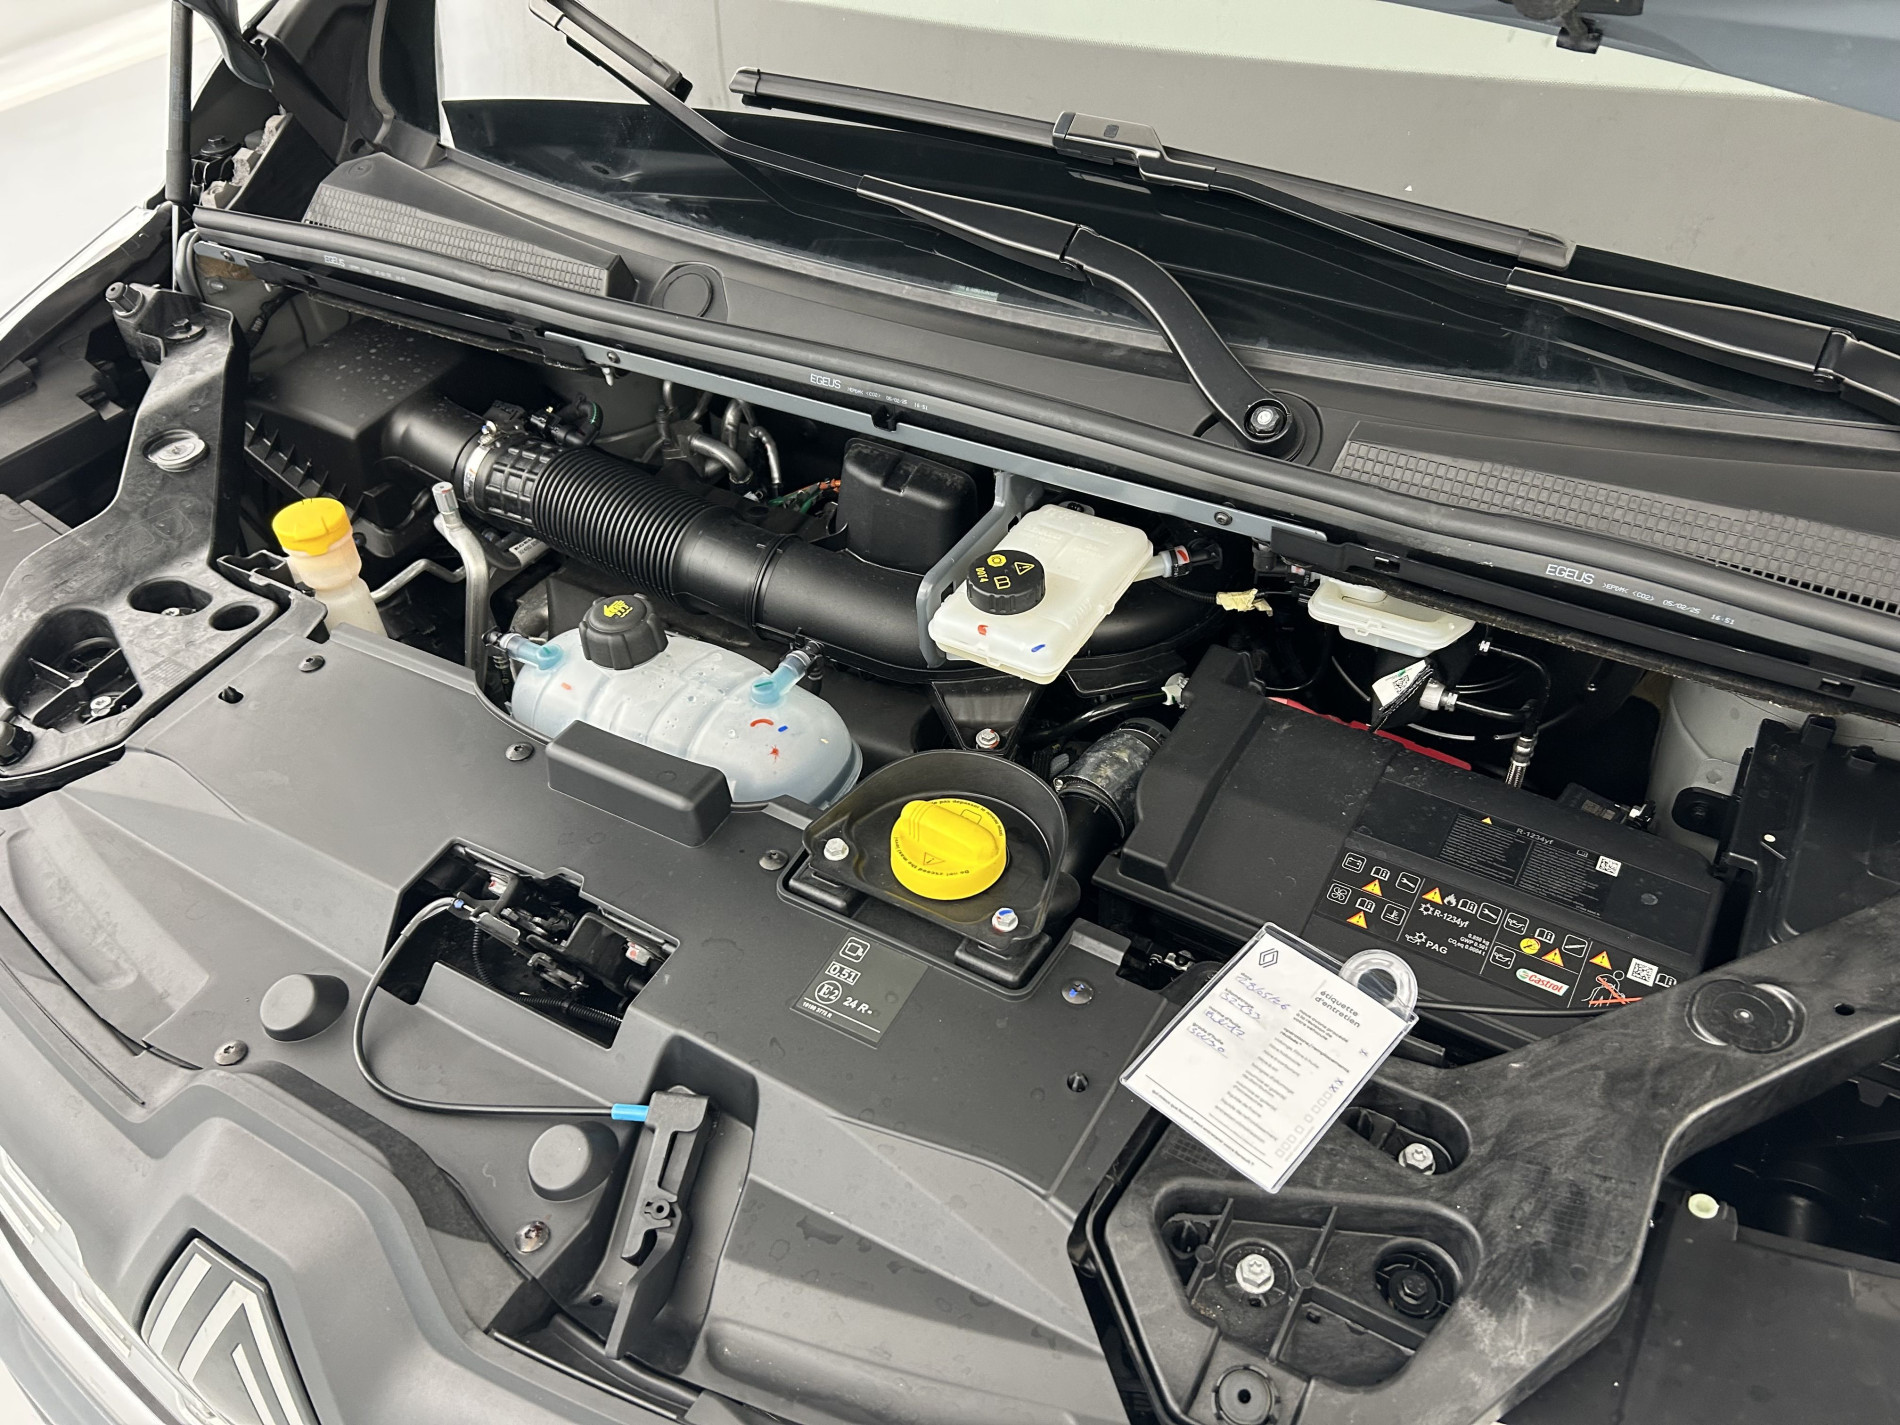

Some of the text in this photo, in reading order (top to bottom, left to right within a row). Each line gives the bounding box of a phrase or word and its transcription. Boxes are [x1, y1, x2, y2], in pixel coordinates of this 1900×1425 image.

[810, 373, 842, 390] EGEUS
[1545, 563, 1595, 585] EGEUS
[1662, 599, 1701, 615] 05/02/25
[1710, 613, 1735, 626] 16:51
[1516, 827, 1555, 846] R-1234yf
[1433, 909, 1470, 928] R-1234yf
[1425, 940, 1448, 954] PAG
[1460, 936, 1474, 944] GWP
[1482, 938, 1490, 946] kg
[829, 964, 857, 983] 0,51
[1528, 972, 1563, 994] Castrol
[818, 984, 839, 1000] E2
[842, 996, 857, 1009] 24
[1320, 990, 1358, 1017] étiquette
[1314, 996, 1360, 1028] d'entretien
